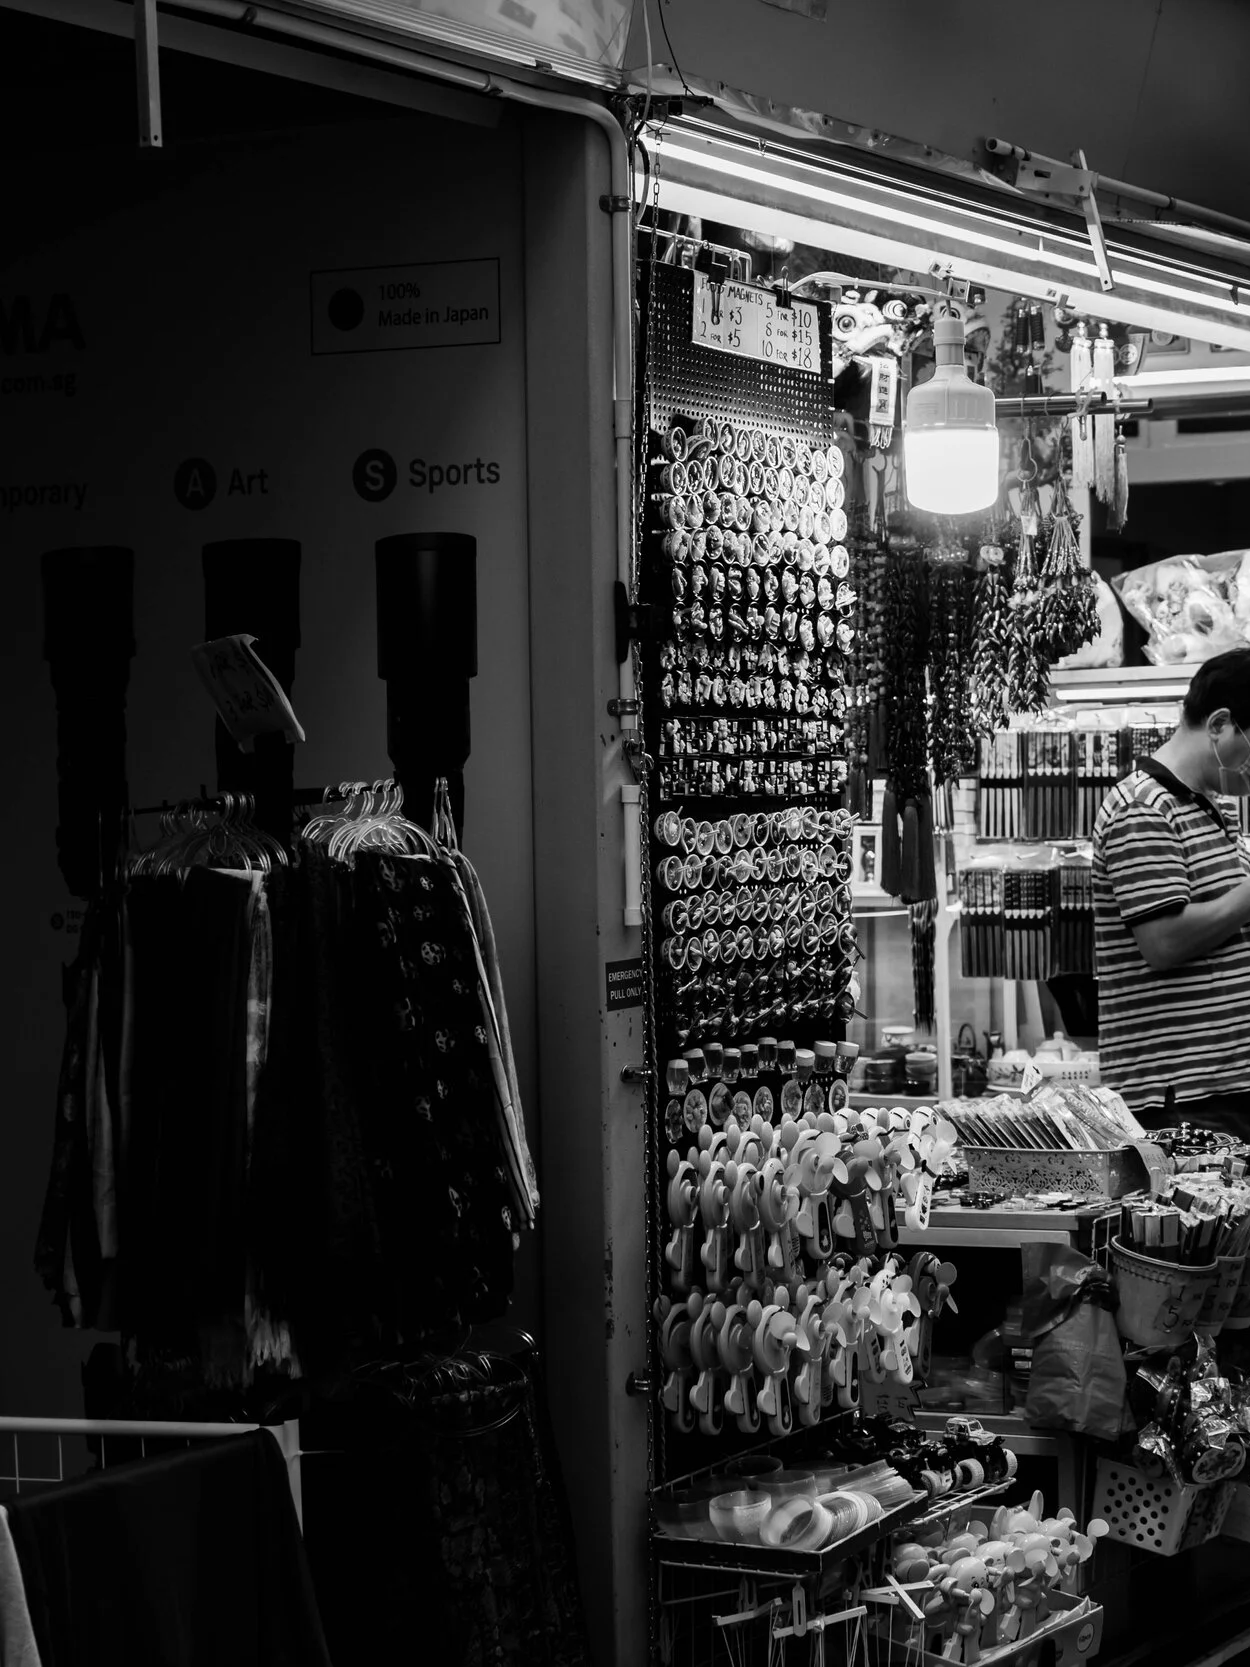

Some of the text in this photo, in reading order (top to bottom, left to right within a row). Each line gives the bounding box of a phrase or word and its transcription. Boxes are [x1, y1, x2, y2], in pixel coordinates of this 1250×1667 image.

[378, 282, 421, 301] 100%
[727, 285, 763, 306] MAGNETS
[378, 306, 489, 327] Made in Japan
[729, 306, 743, 325] $3
[765, 301, 774, 319] 5
[791, 308, 812, 328] $10
[700, 320, 741, 348] 2 FOR $5
[765, 321, 812, 346] 8 FOR $15
[761, 339, 812, 369] 10 FOR $18
[228, 468, 268, 496] Art
[409, 457, 500, 494] Sports
[608, 968, 643, 982] EMERGENCY
[610, 986, 642, 1000] PULL ONLY
[1162, 1304, 1179, 1329] 5
